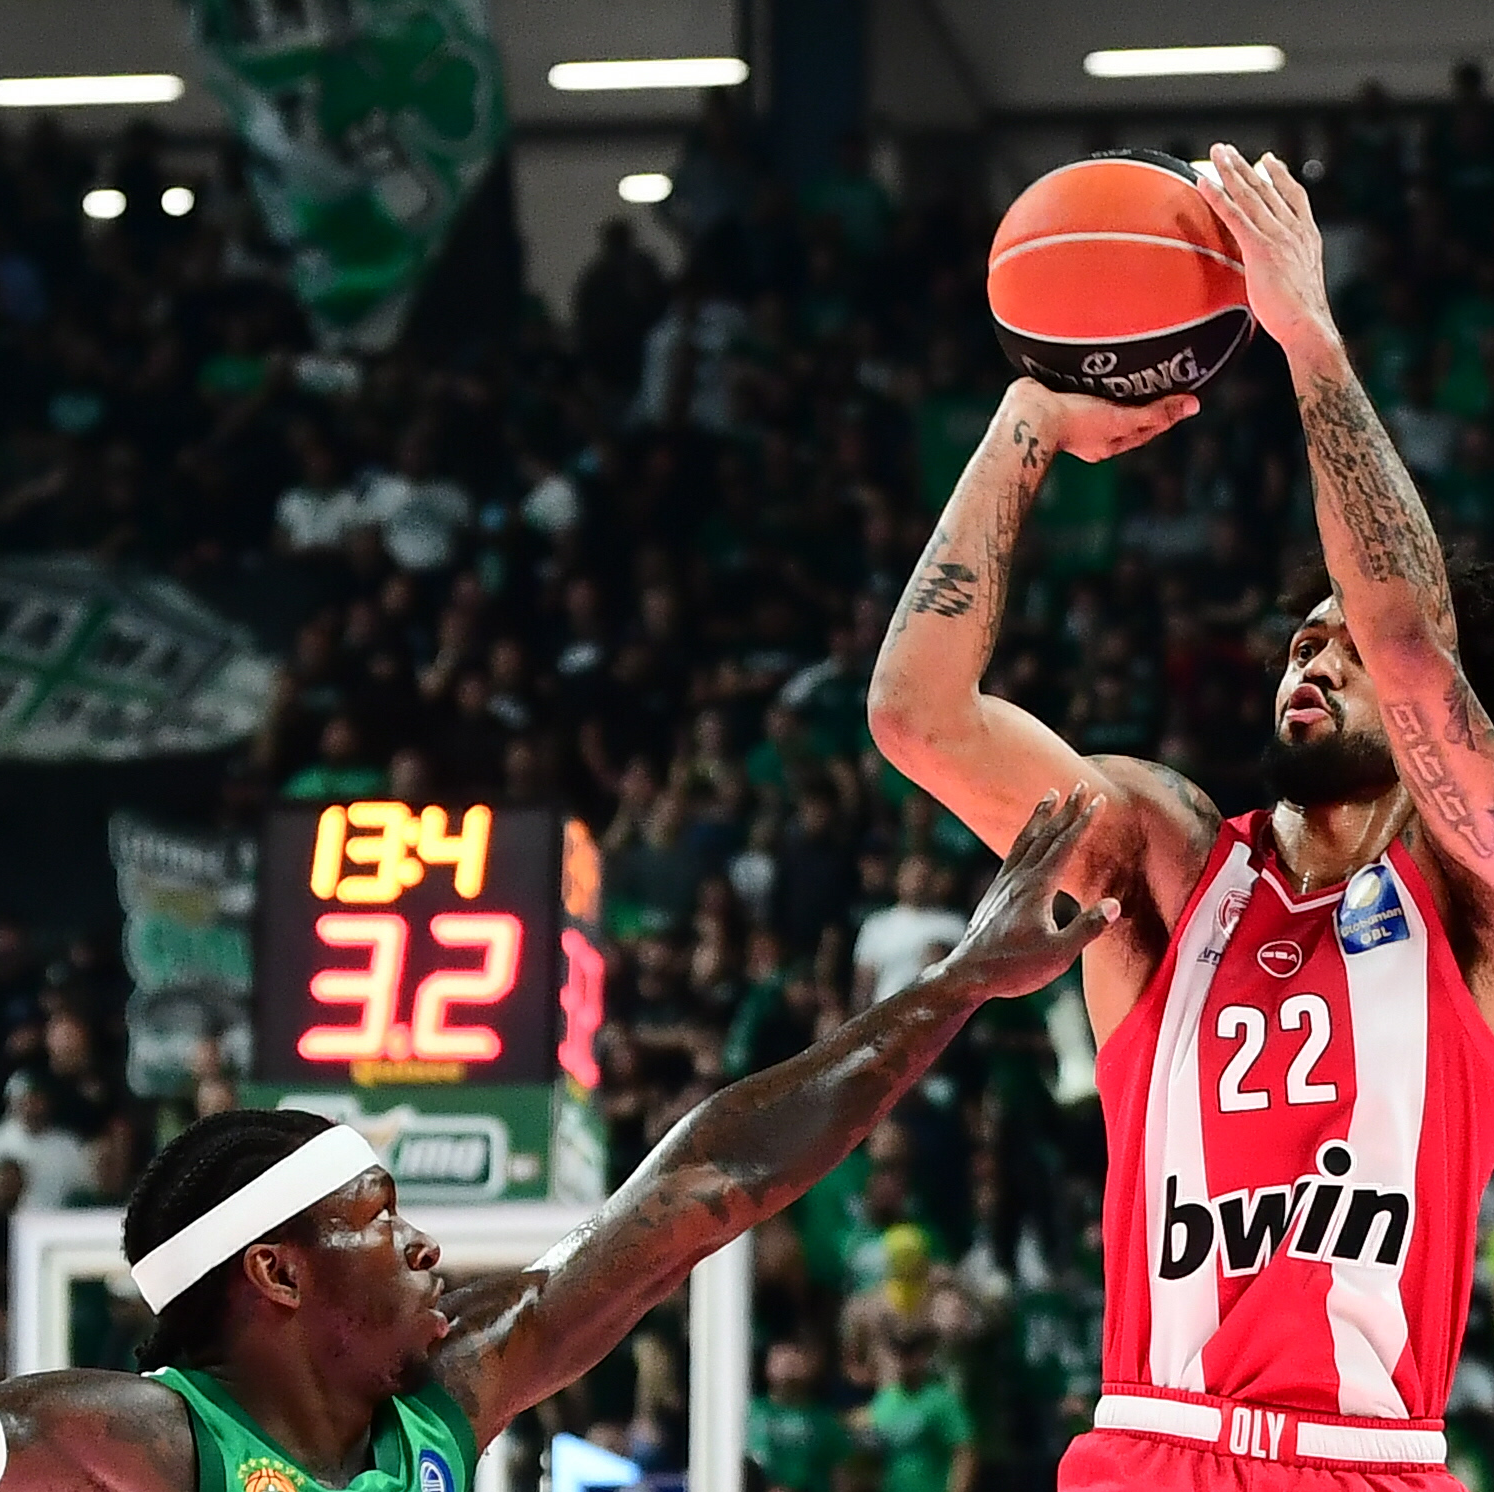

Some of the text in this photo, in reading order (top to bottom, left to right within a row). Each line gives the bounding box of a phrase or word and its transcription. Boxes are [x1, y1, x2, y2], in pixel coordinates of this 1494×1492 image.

[1021, 347, 1200, 398] DING
[310, 801, 492, 904] 13:4
[297, 911, 523, 1062] 3.2
[1215, 993, 1338, 1114] 22
[1158, 1145, 1410, 1281] bwin
[1229, 1406, 1286, 1461] OLY
